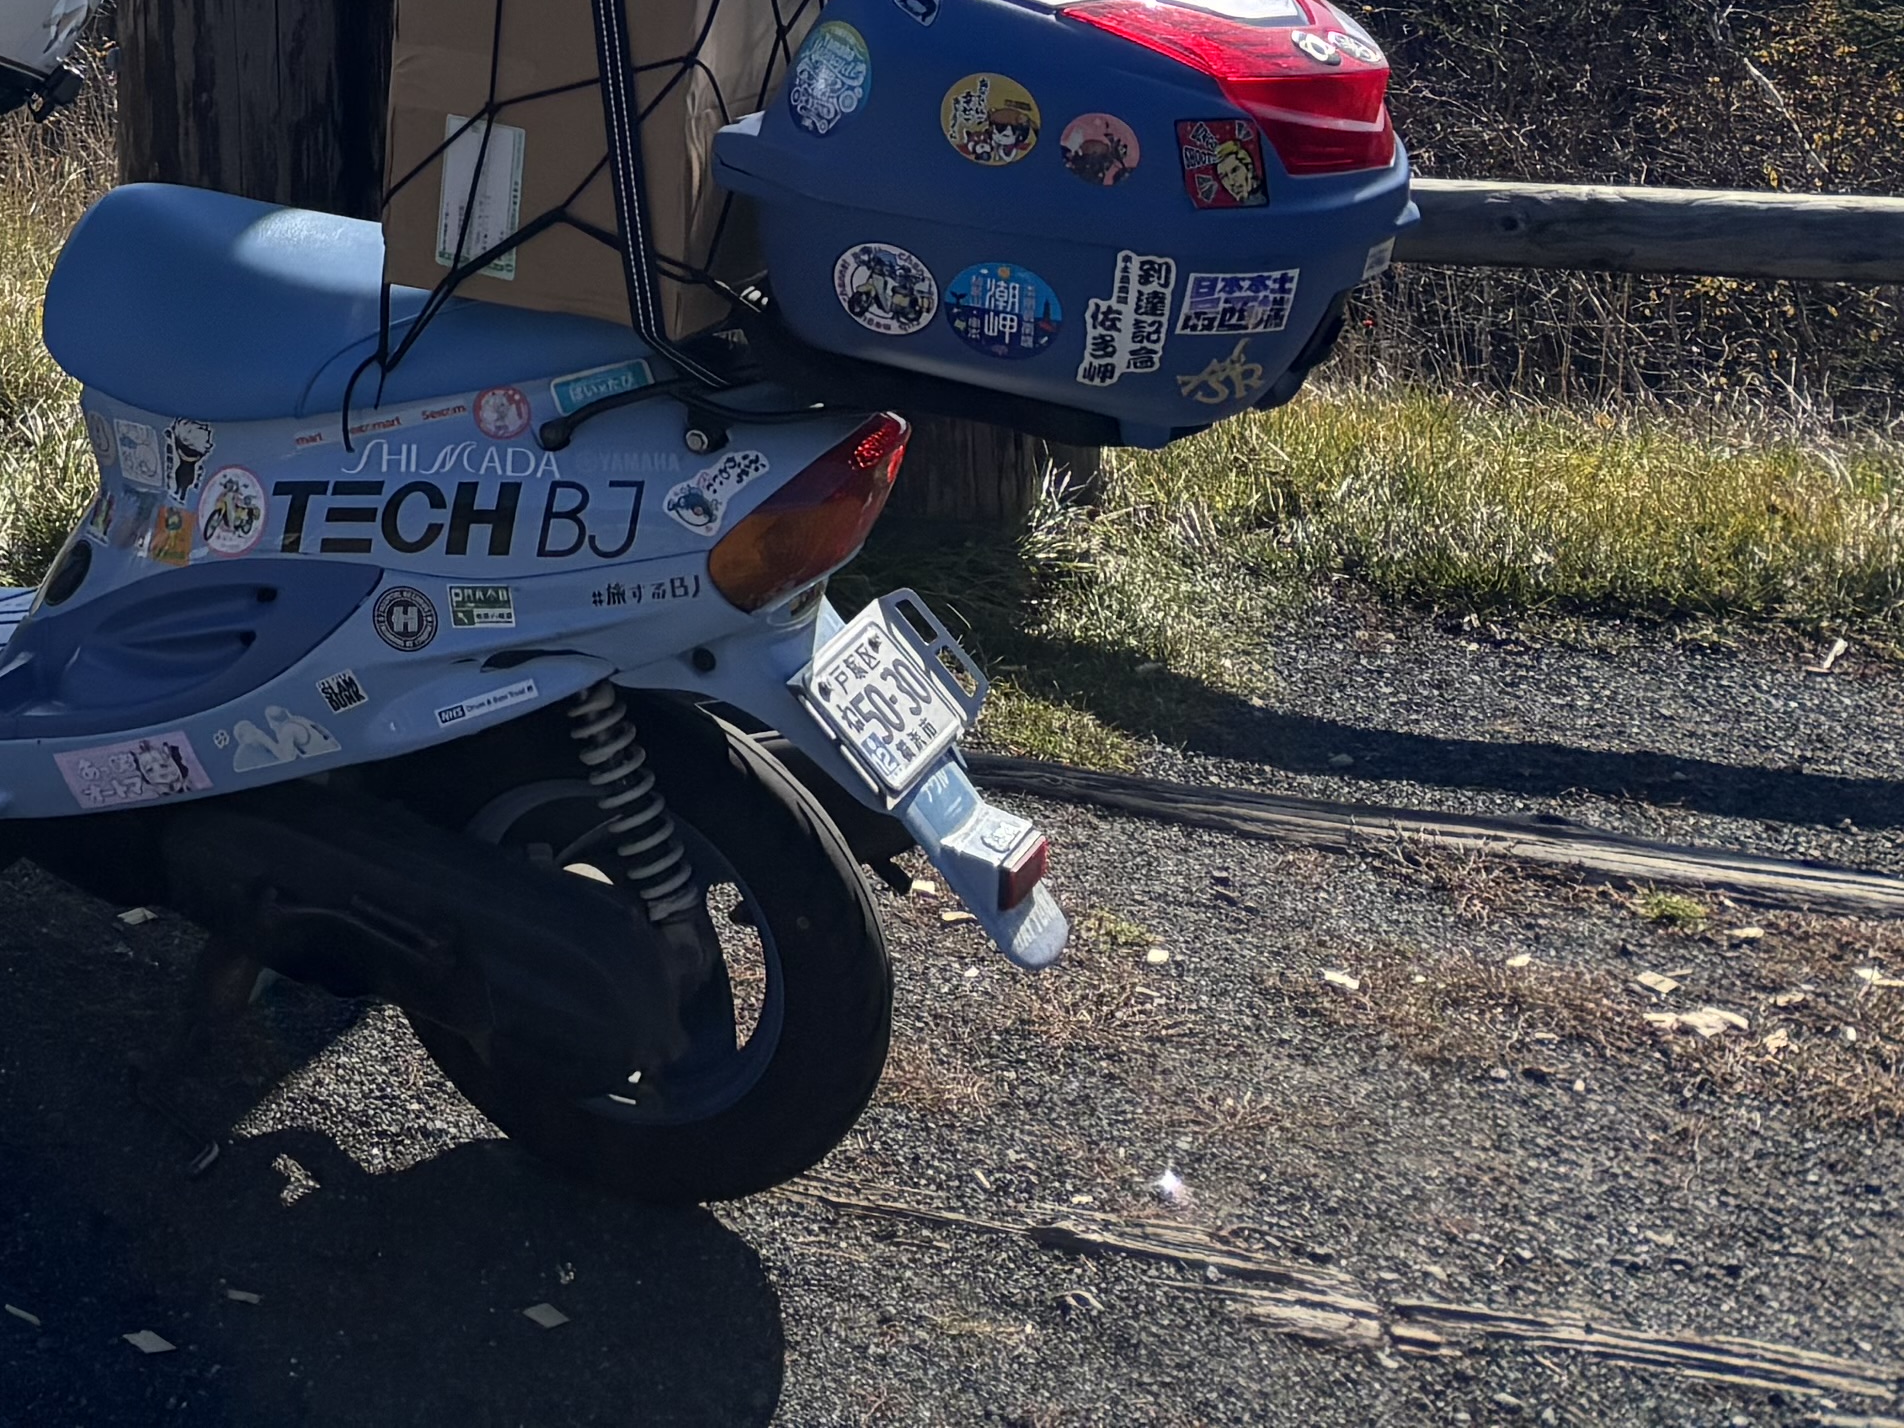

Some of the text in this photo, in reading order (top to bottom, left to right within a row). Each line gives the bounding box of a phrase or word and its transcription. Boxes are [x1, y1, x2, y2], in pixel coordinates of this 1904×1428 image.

[984, 277, 1019, 345] 潮岬
[1082, 302, 1123, 384] 佐多岬
[1126, 259, 1172, 370] 到達記念
[271, 479, 645, 558] TECH BJ
[848, 657, 933, 745] 50-30
